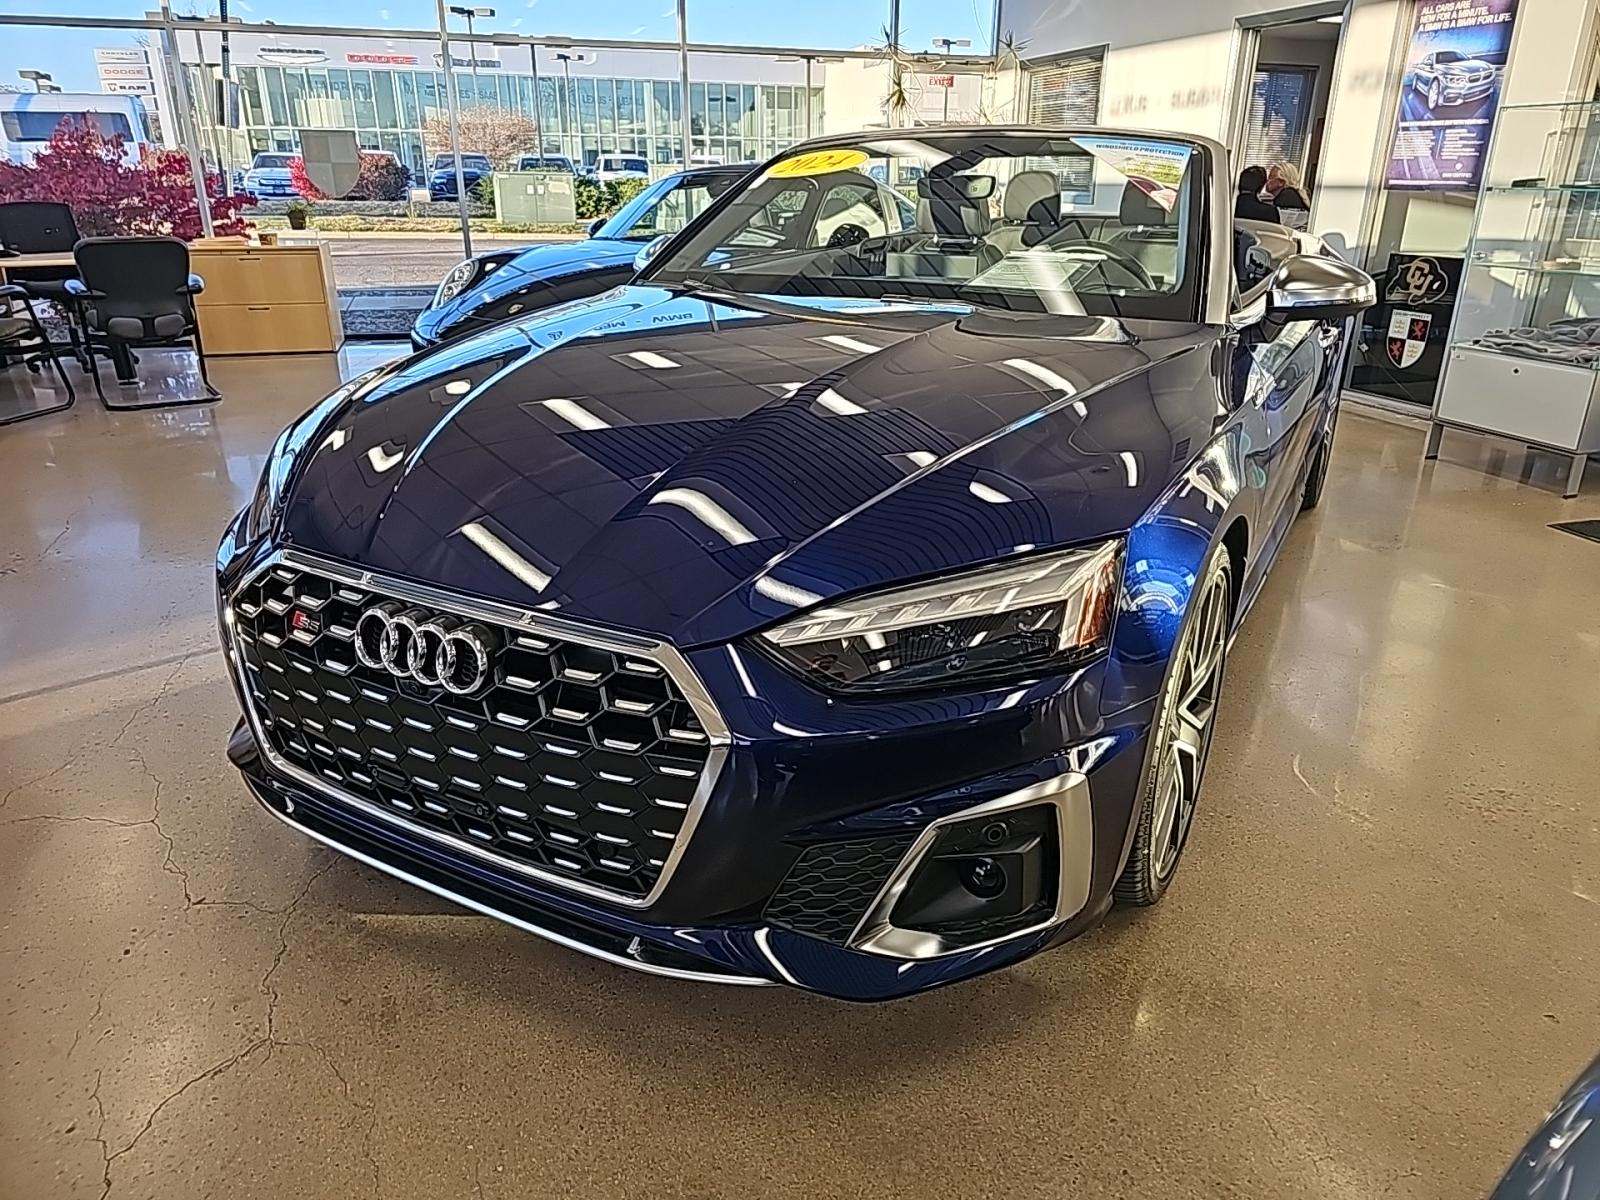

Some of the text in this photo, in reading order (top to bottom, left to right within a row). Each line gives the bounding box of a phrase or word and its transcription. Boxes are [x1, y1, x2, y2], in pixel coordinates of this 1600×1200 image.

[1421, 0, 1471, 15] ALL CARS ARE
[1418, 23, 1425, 32] A
[1425, 22, 1441, 31] BMW
[1442, 21, 1450, 30] IS
[1450, 20, 1457, 28] A
[1457, 17, 1477, 27] BMW
[1476, 15, 1494, 25] FOR
[1420, 14, 1436, 23] NEW
[1436, 11, 1451, 21] FOR
[1451, 11, 1458, 19] A
[1096, 143, 1138, 152] WINDSHIELD
[1139, 146, 1185, 157] PROTECTION
[652, 312, 694, 324] BMW
